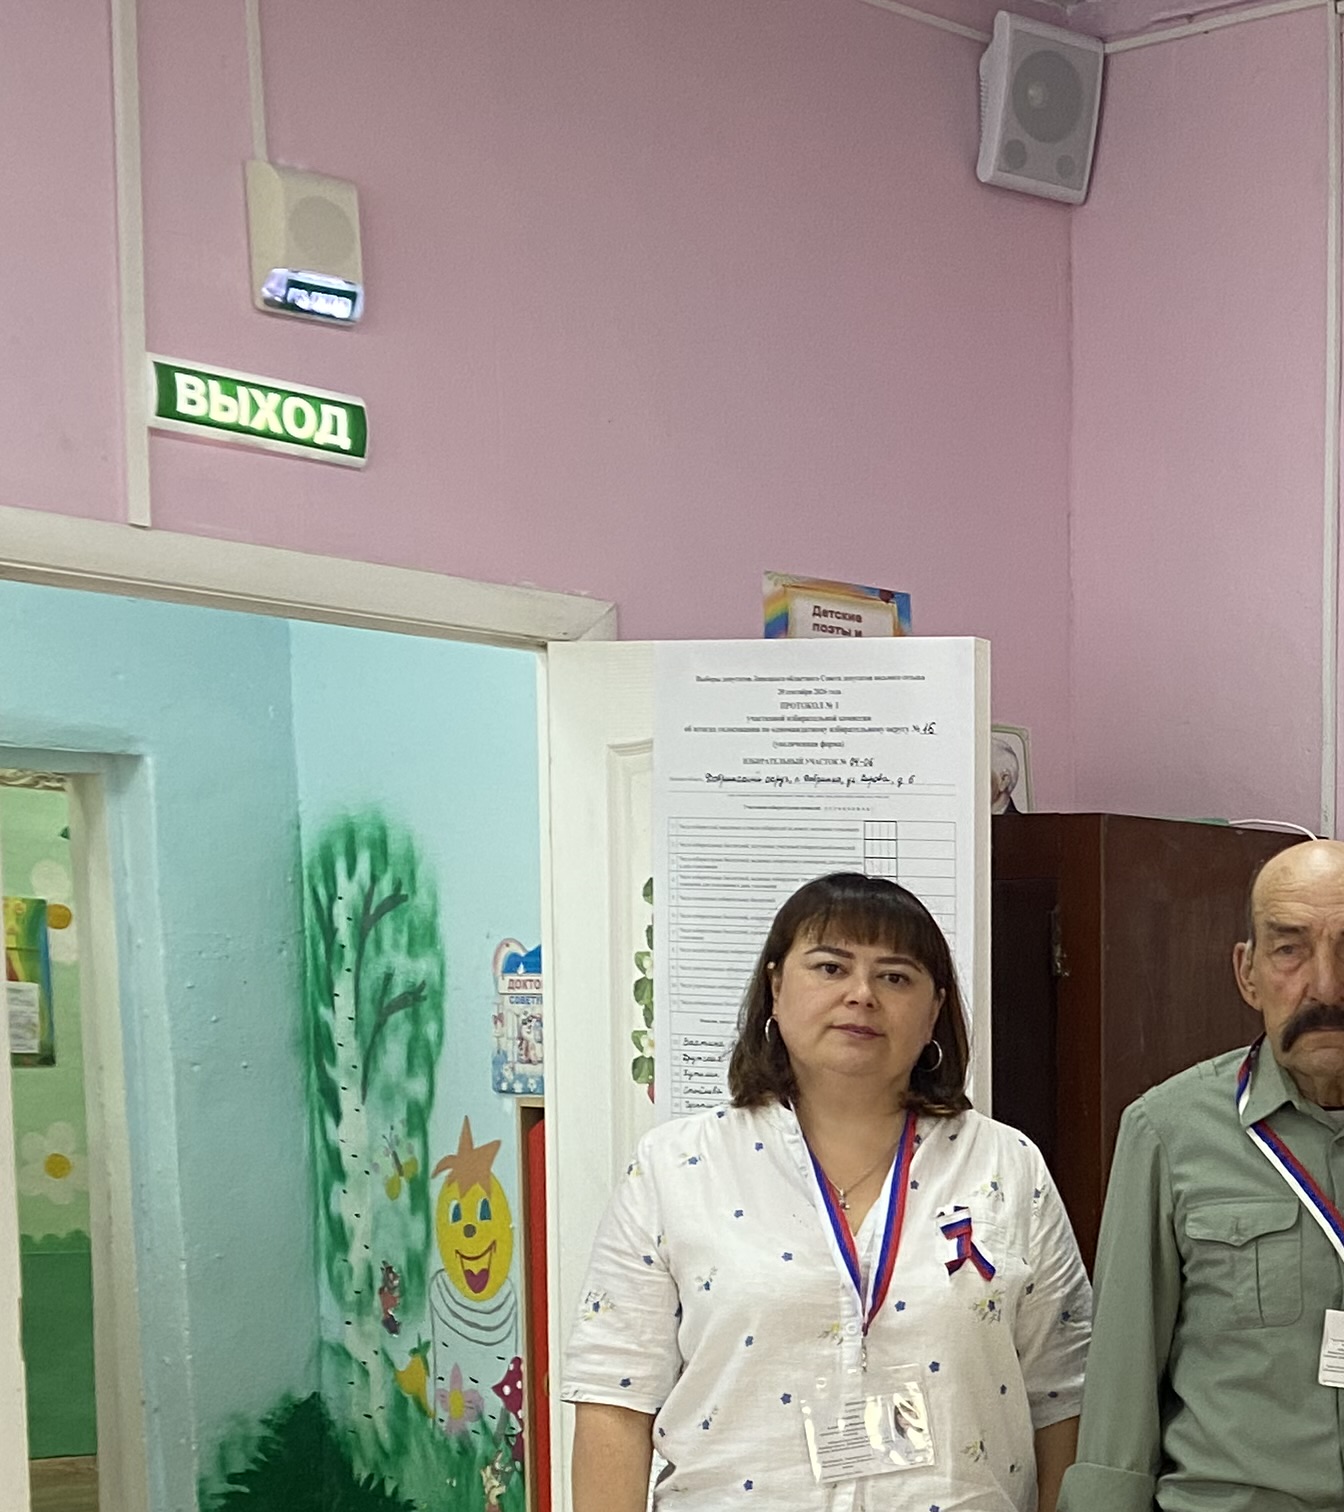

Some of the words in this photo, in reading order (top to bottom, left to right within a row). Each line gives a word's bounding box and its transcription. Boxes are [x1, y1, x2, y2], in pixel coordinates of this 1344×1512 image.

[174, 372, 352, 450] ВЫХОД
[812, 605, 863, 623] Детские
[812, 622, 852, 637] поэты
[507, 978, 543, 990] ДОКТО
